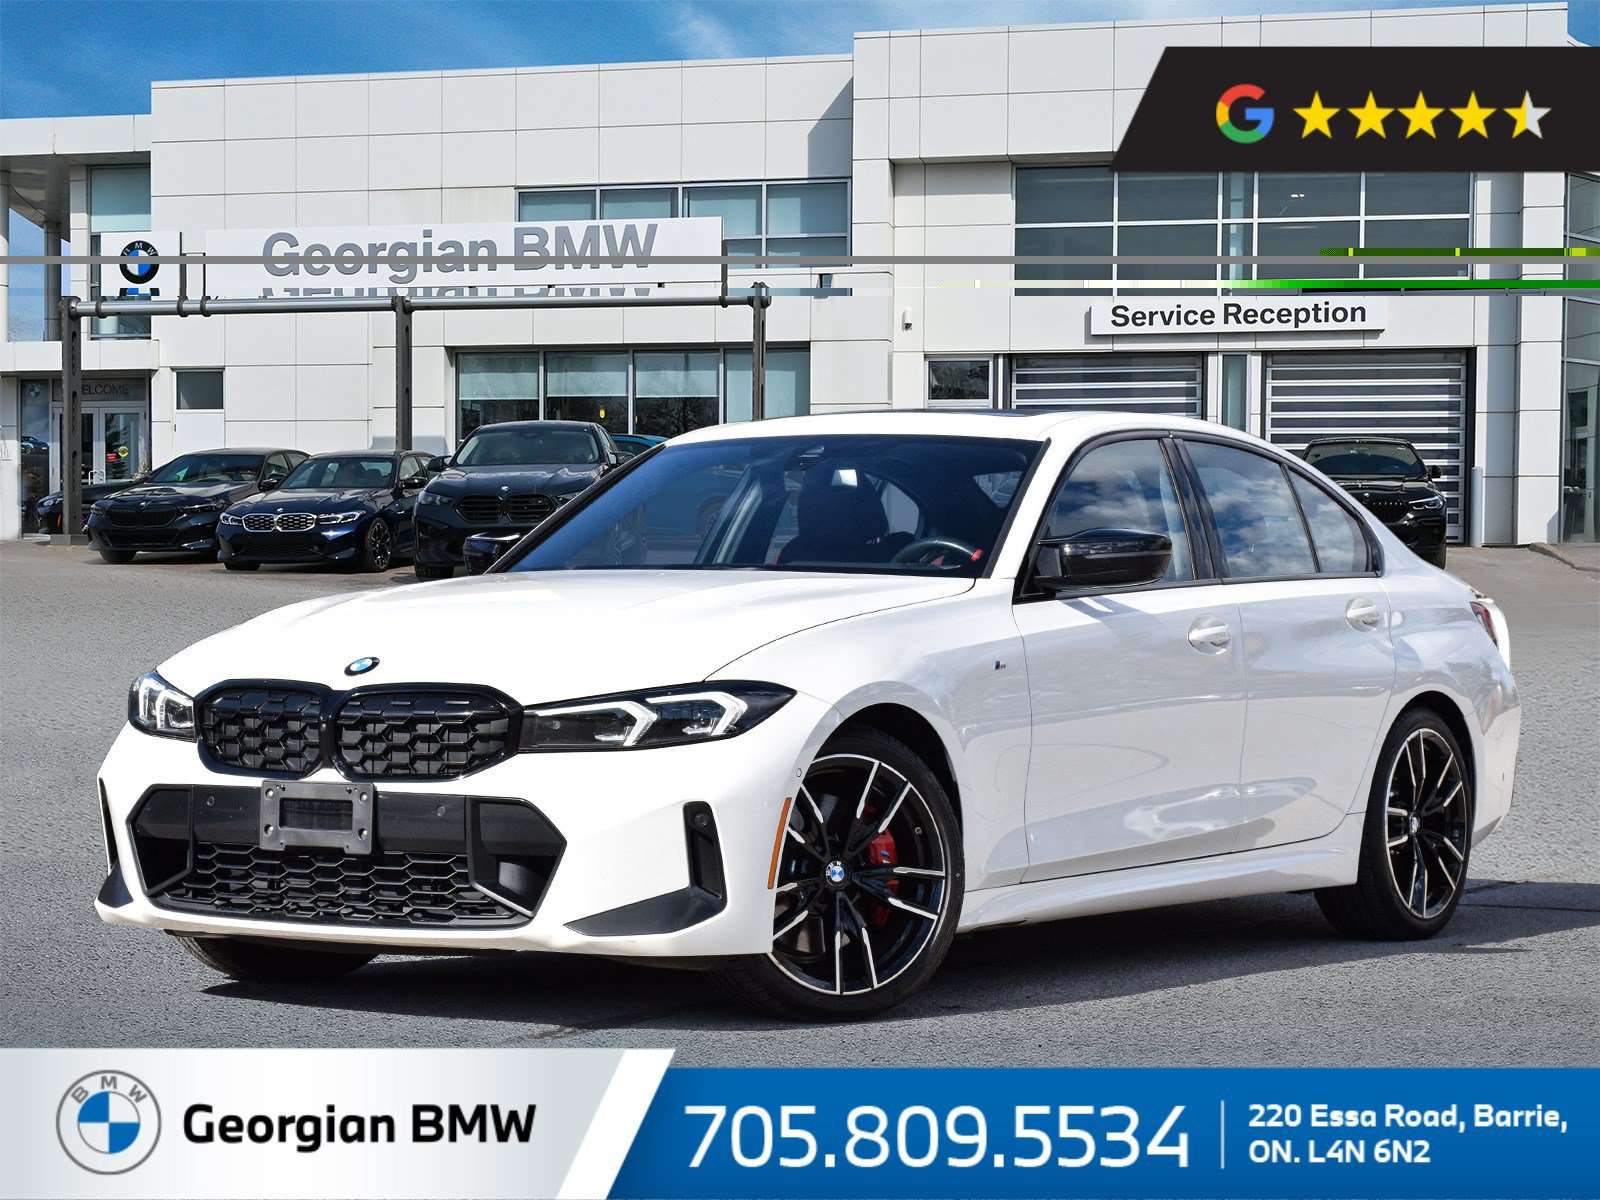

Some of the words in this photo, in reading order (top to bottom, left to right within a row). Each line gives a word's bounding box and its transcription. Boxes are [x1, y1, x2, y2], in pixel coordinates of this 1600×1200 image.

[262, 229, 498, 284] Georgian
[513, 224, 658, 270] BMW
[1111, 304, 1216, 327] Service
[1223, 301, 1367, 328] Reception
[81, 383, 130, 395] ELCOME
